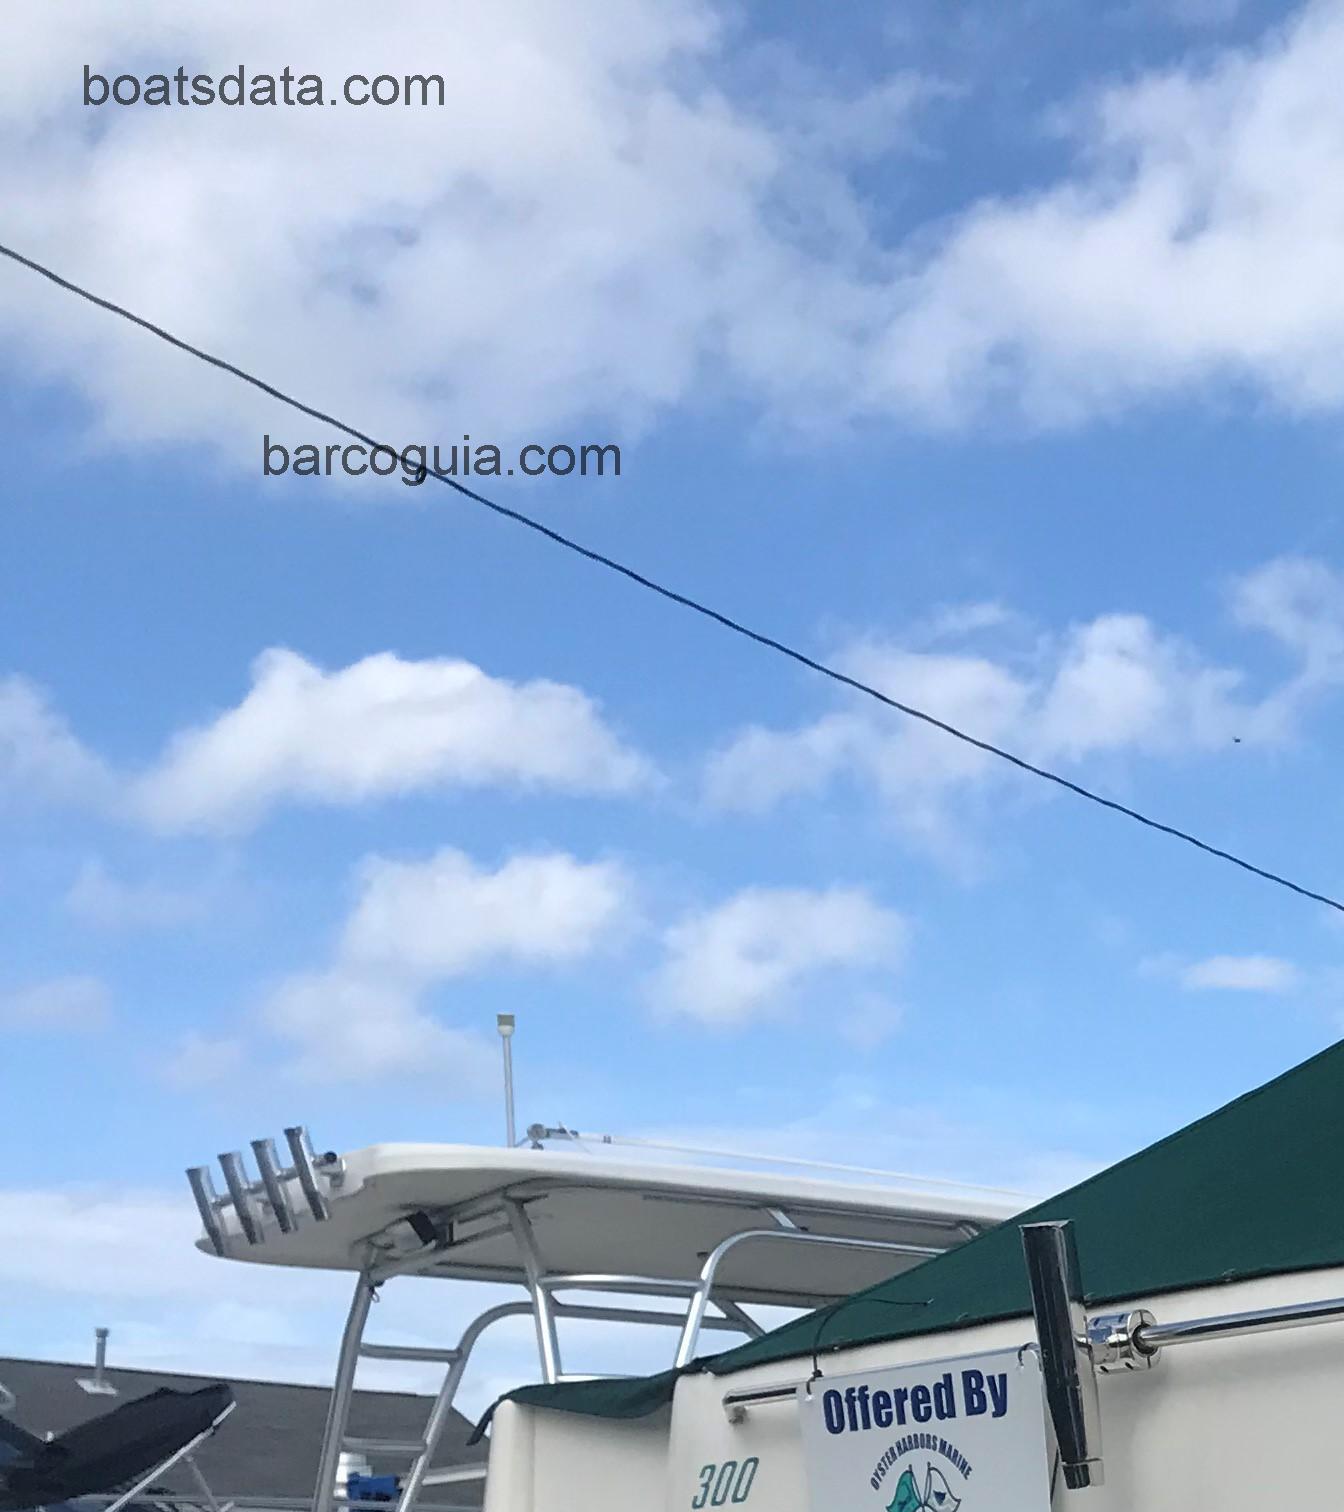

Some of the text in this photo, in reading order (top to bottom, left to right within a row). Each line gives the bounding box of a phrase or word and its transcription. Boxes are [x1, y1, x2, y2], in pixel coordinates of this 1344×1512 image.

[822, 1369, 1008, 1435] Offered By
[692, 1457, 760, 1509] 300
[870, 1433, 973, 1491] OYSTER HARBORS MARINE
